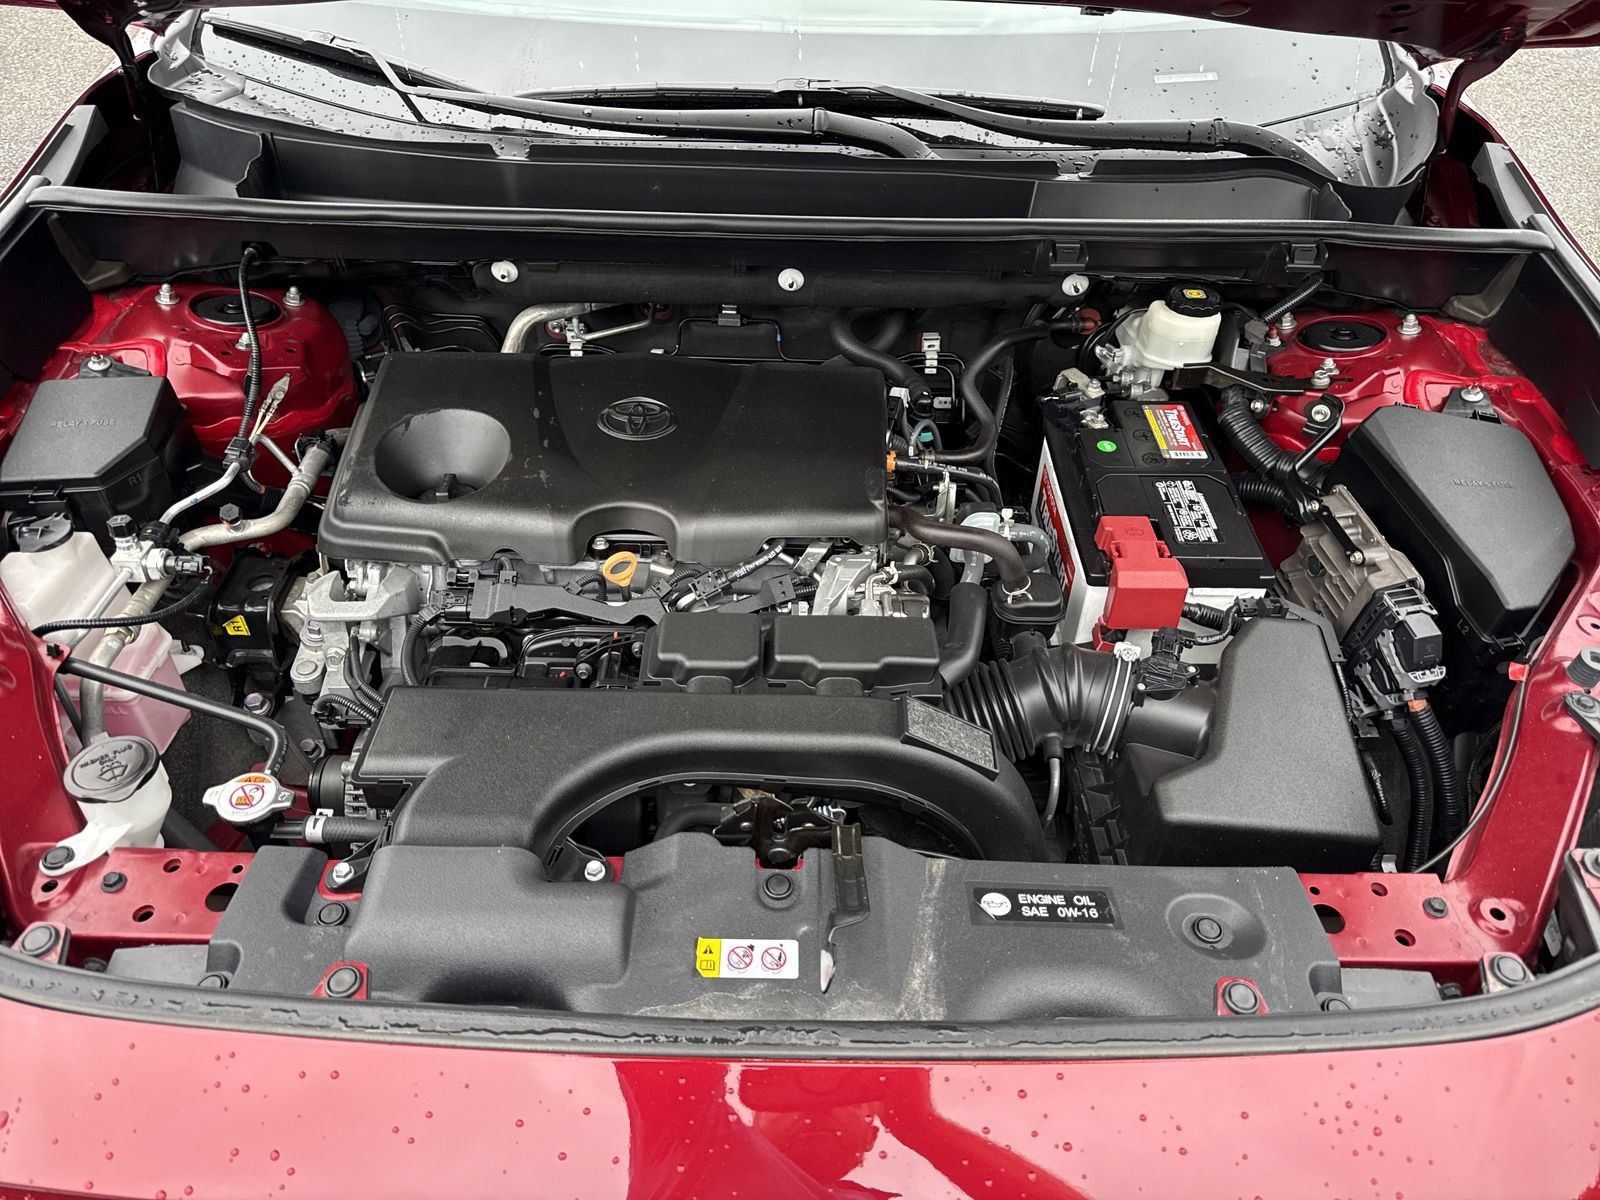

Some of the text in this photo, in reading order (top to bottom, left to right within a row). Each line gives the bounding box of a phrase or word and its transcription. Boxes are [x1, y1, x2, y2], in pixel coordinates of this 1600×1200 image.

[79, 753, 110, 768] WASHER
[1017, 893, 1096, 906] ENGINE OIL
[1021, 906, 1099, 918] SAE 0W-16
